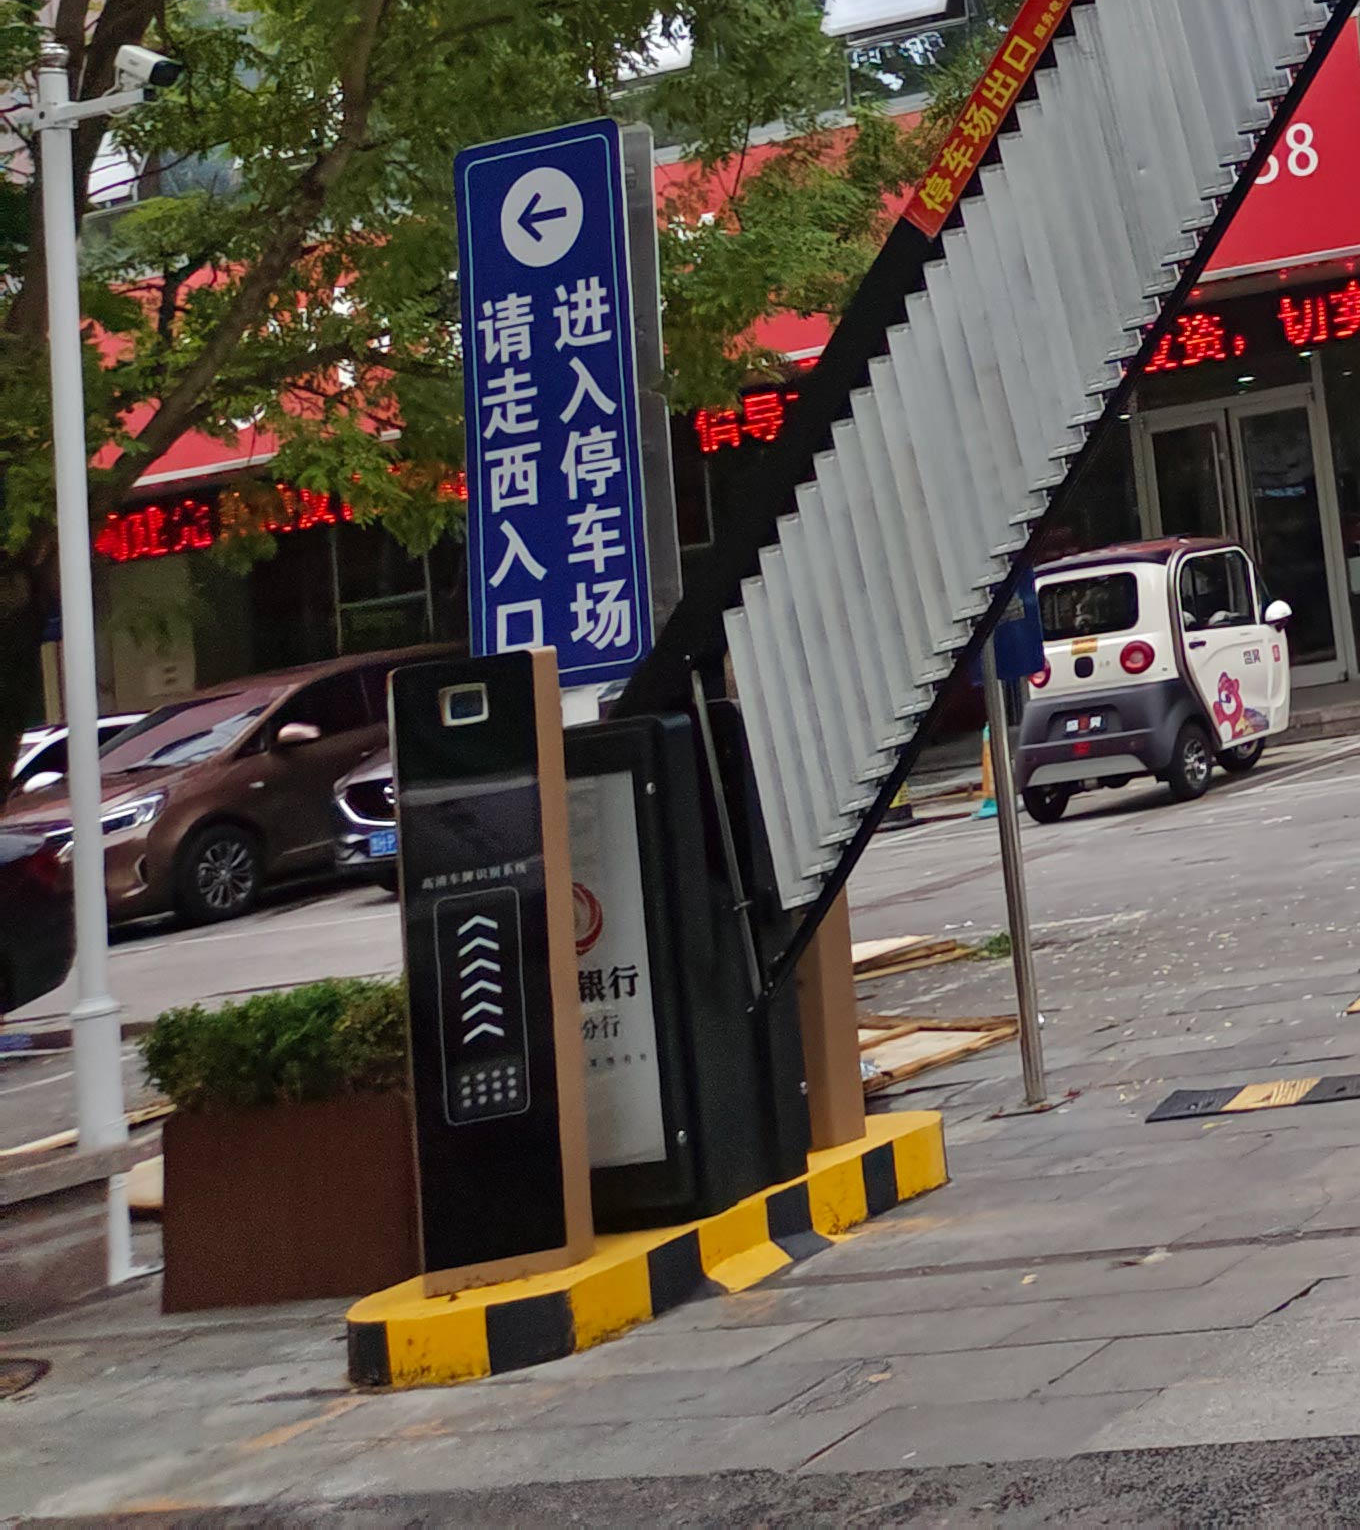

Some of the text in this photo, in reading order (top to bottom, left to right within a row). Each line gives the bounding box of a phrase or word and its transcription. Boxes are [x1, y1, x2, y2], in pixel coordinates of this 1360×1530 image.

[918, 34, 1036, 215] 停车场出口
[477, 292, 547, 654] 请走西入口
[553, 276, 631, 650] 进入停车场
[421, 862, 527, 889] 高清车牌识别系统
[583, 1015, 621, 1040] 分行
